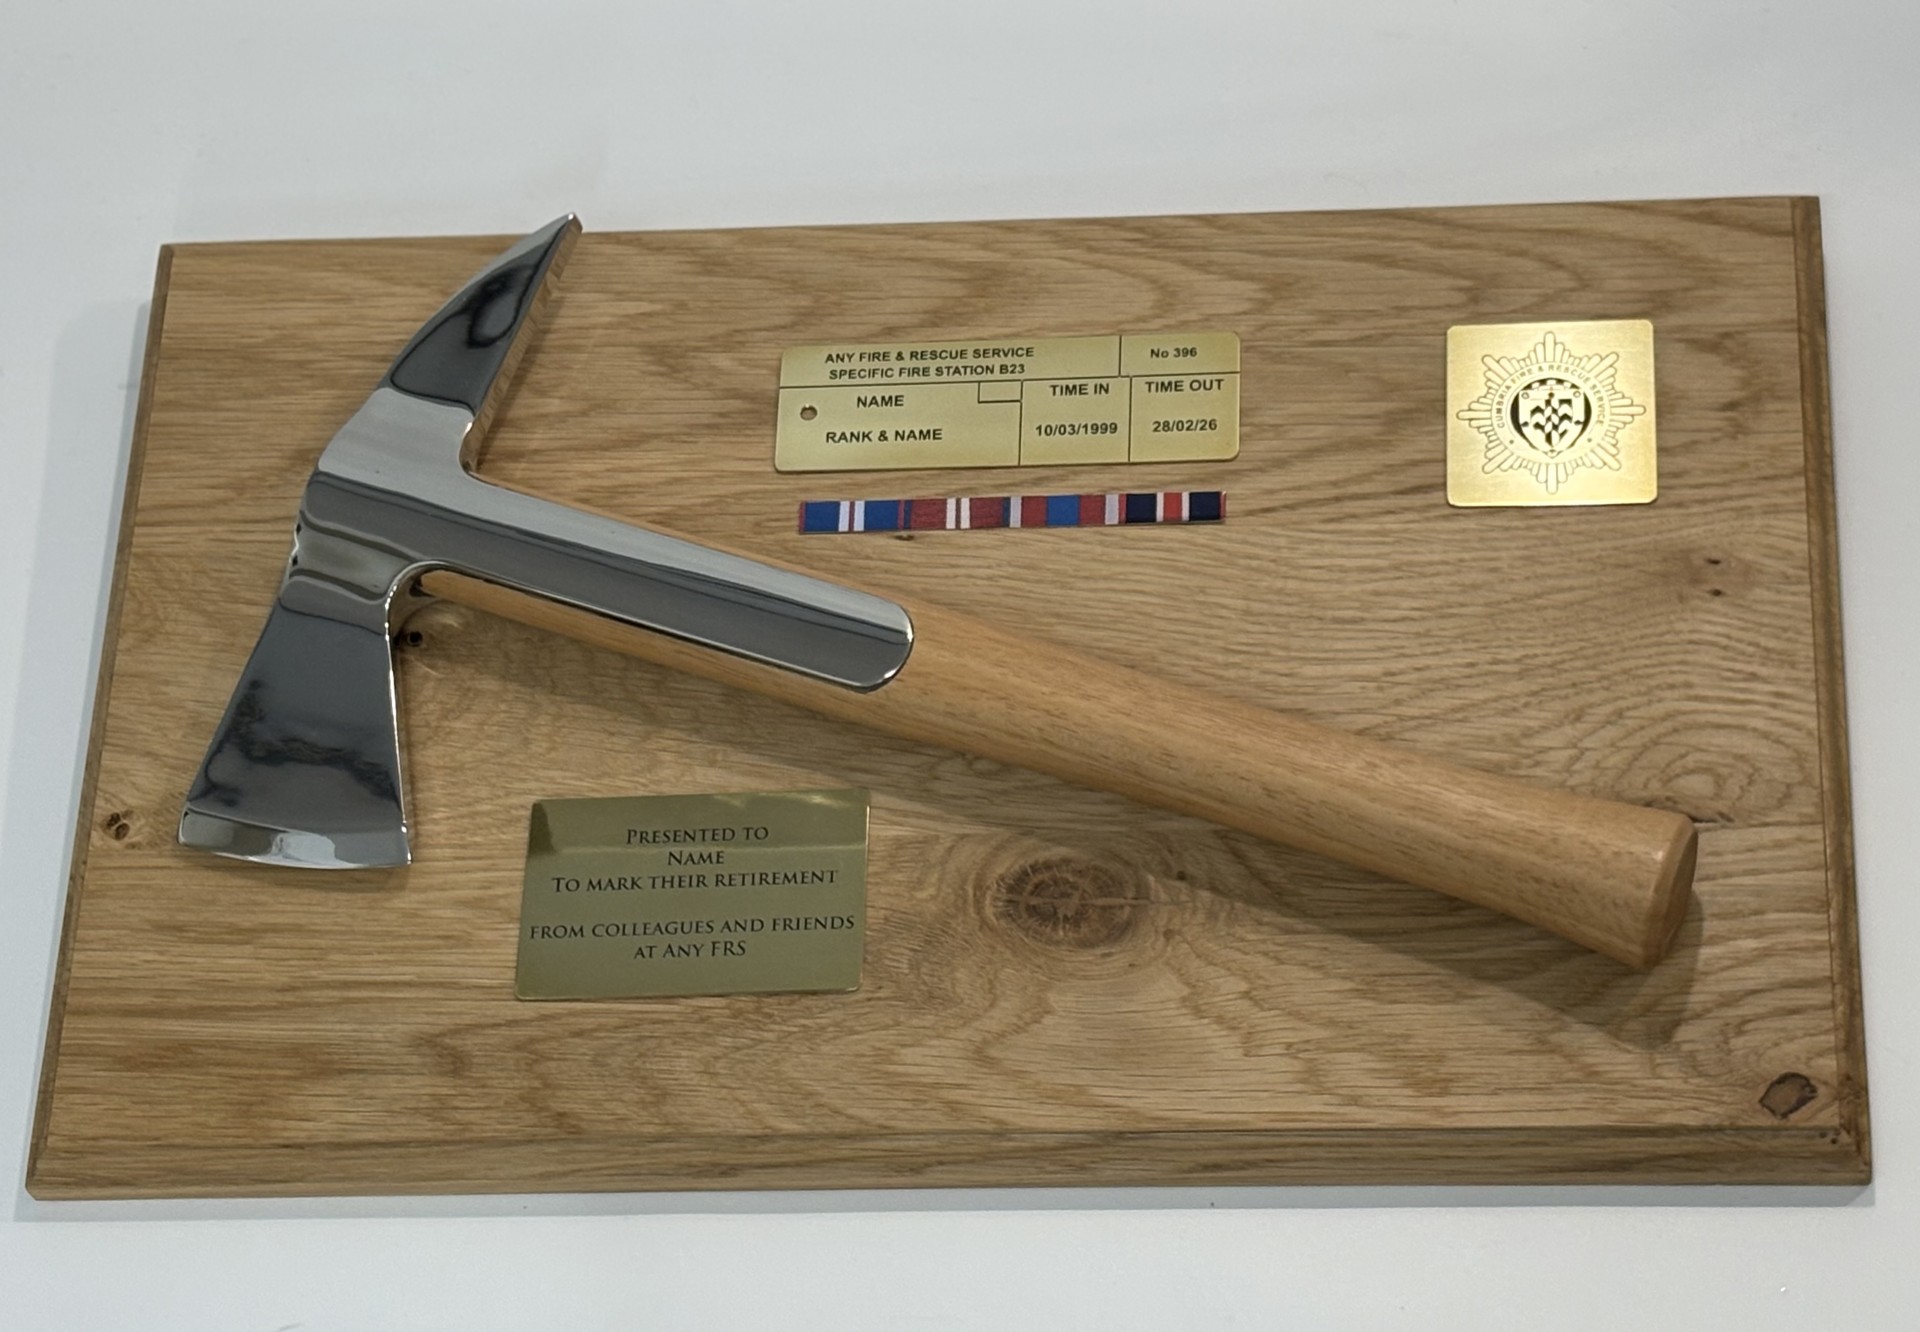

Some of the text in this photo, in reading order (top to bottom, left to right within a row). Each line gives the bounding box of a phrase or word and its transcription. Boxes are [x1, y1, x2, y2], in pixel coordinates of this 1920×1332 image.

[825, 346, 1035, 364] ANY FIRE & RESCUE SERVICE
[1150, 347, 1197, 358] No 396
[829, 363, 1025, 380] SPECIFIC FIRE STATION B23
[1049, 382, 1110, 397] TIME IN
[1145, 379, 1224, 393] TIME OUT
[856, 395, 905, 408] NAME
[1035, 422, 1118, 437] 10/03/1999
[1152, 419, 1217, 433] 28/02/26
[826, 428, 943, 443] RANK & NAME
